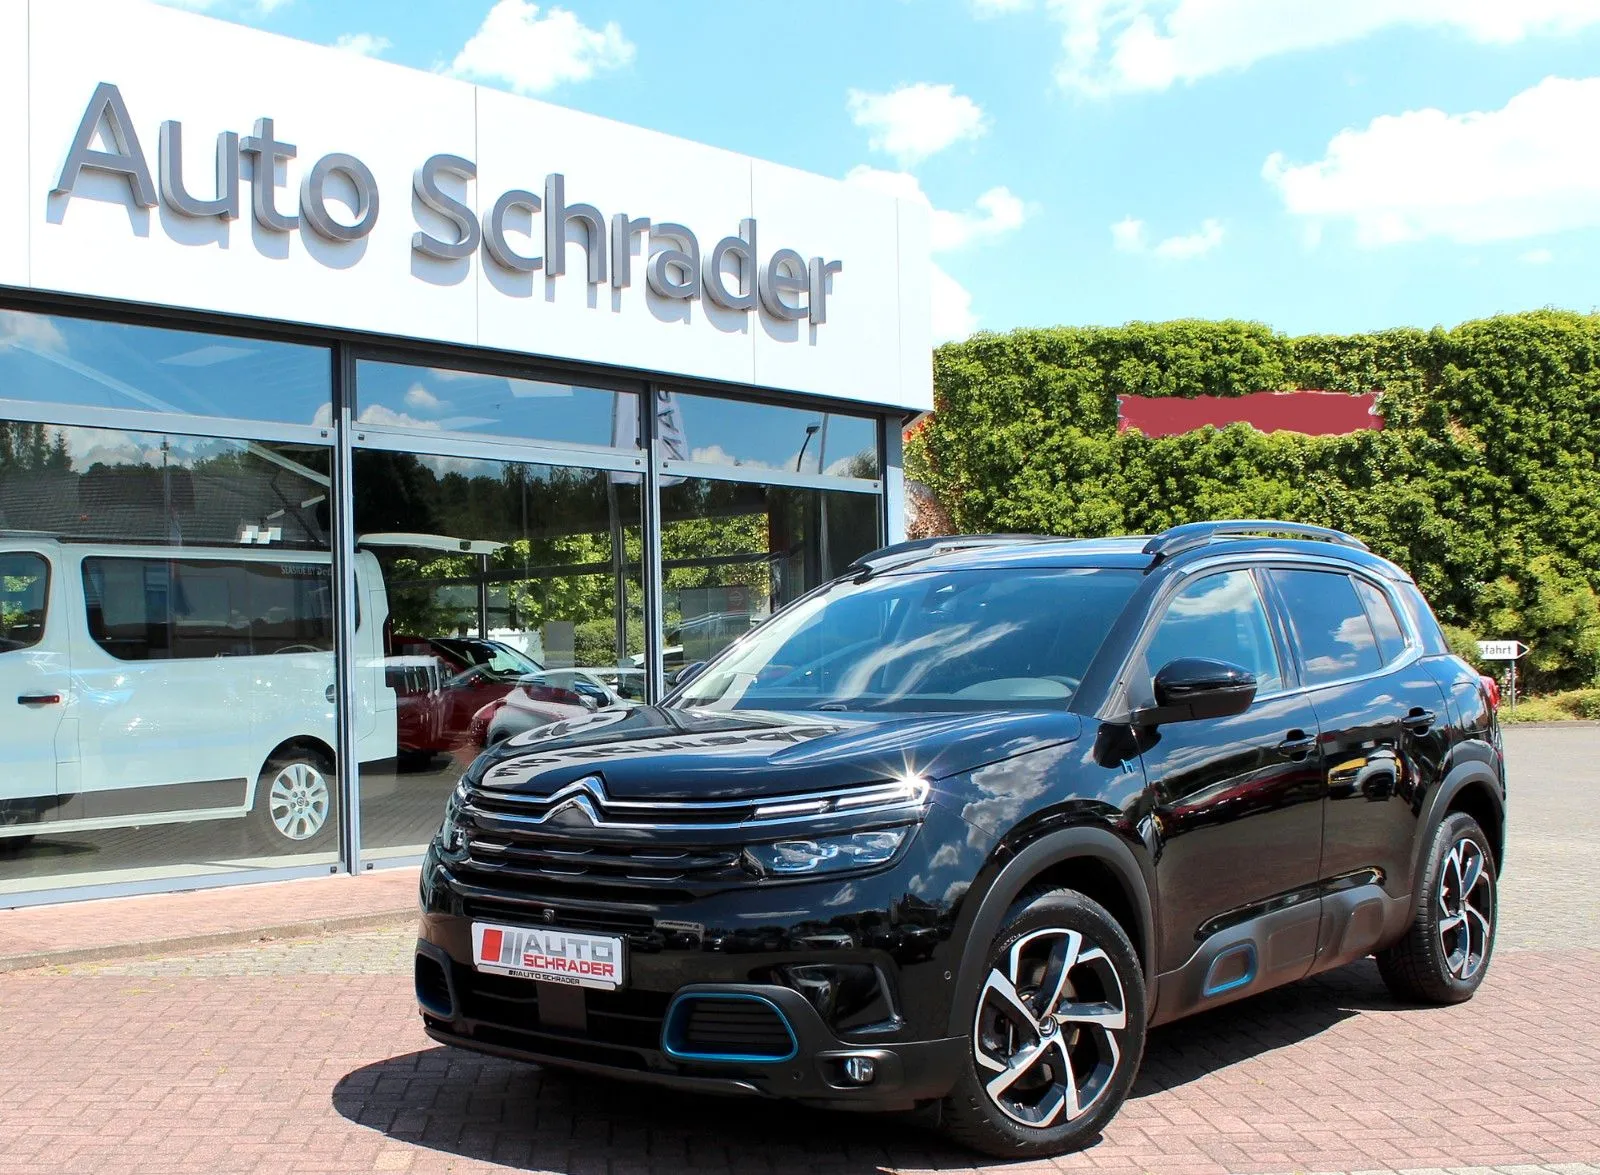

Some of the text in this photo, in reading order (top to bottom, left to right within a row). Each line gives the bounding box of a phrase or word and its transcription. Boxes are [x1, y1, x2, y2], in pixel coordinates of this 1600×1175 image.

[49, 81, 842, 325] Auto Schrader
[1480, 644, 1512, 655] sfahrt
[523, 934, 613, 963] AUTO
[523, 953, 614, 977] SCHRADER
[517, 971, 580, 984] AUTO SCHRADER
